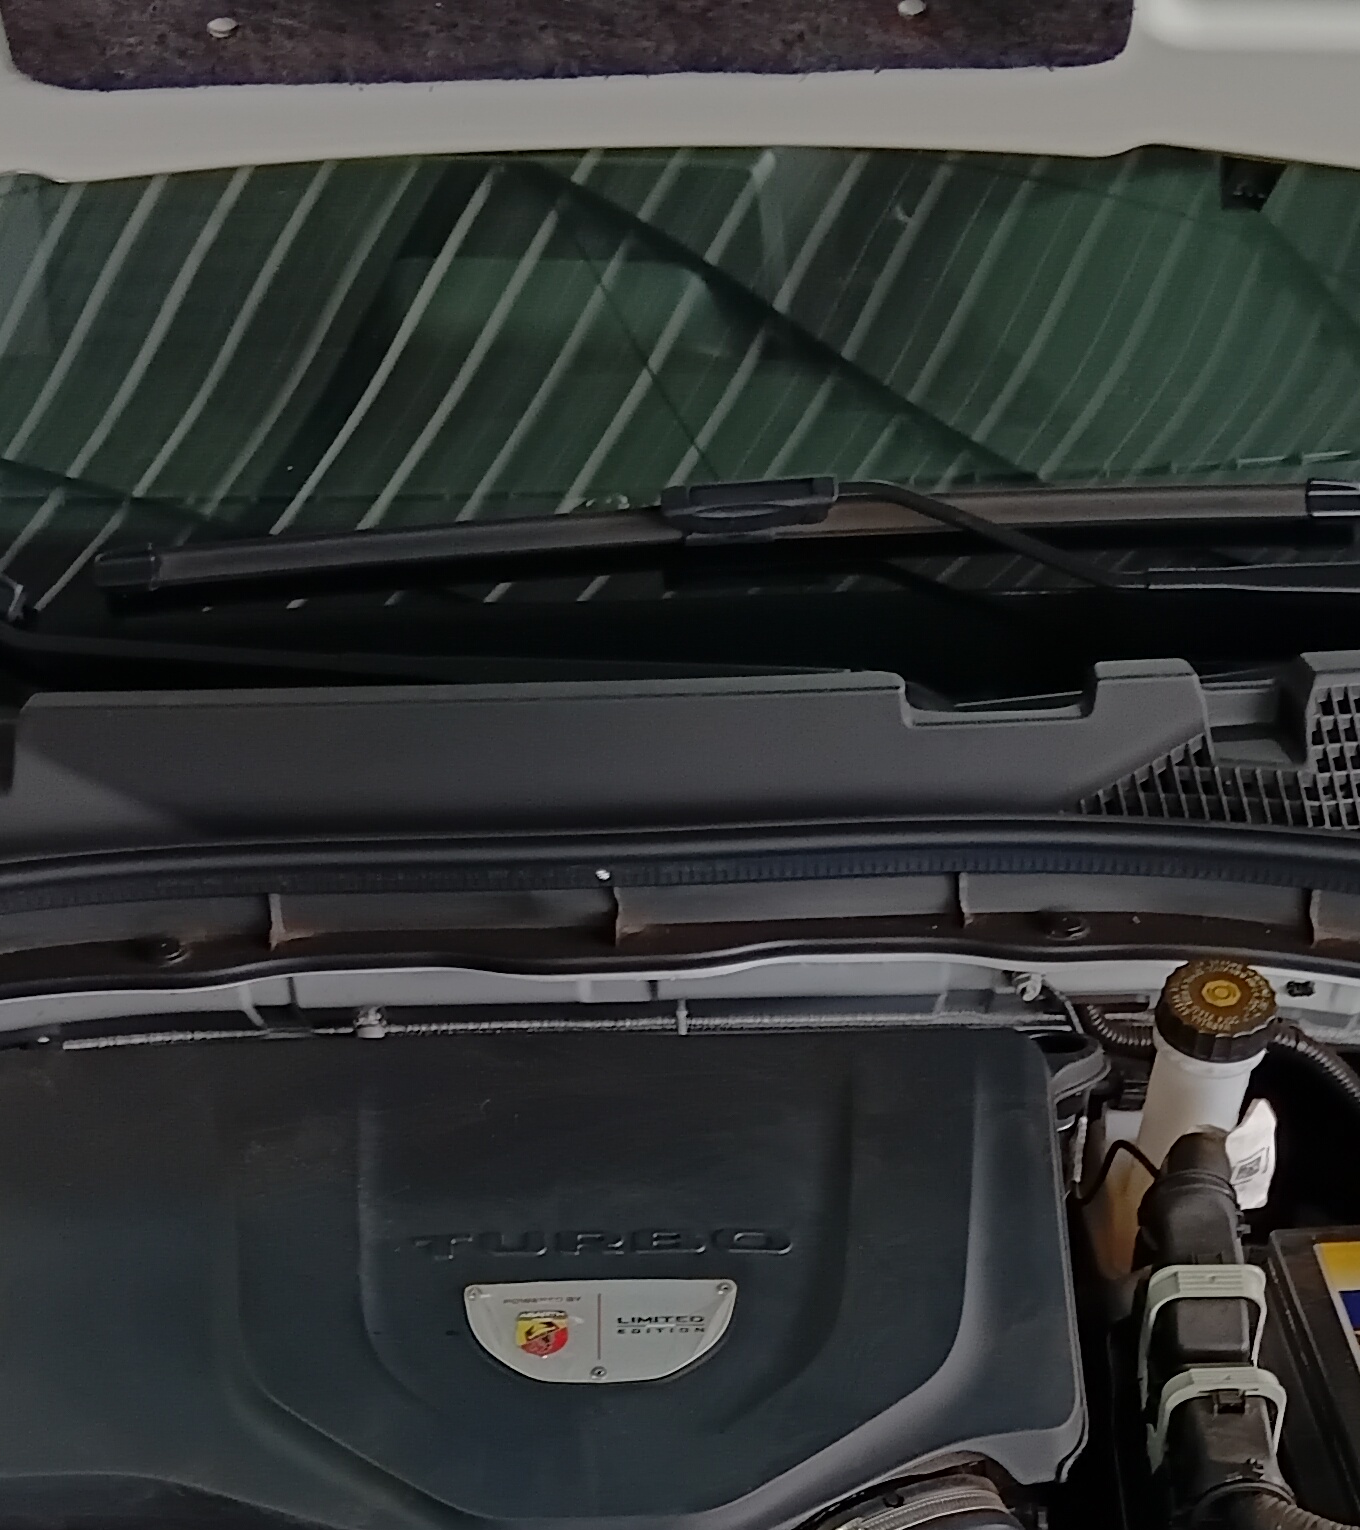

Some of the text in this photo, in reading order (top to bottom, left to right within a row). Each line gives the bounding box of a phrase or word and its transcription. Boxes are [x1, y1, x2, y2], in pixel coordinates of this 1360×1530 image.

[411, 1228, 793, 1259] TURBO
[617, 1315, 705, 1324] LIMITED
[617, 1327, 705, 1335] EDITION
